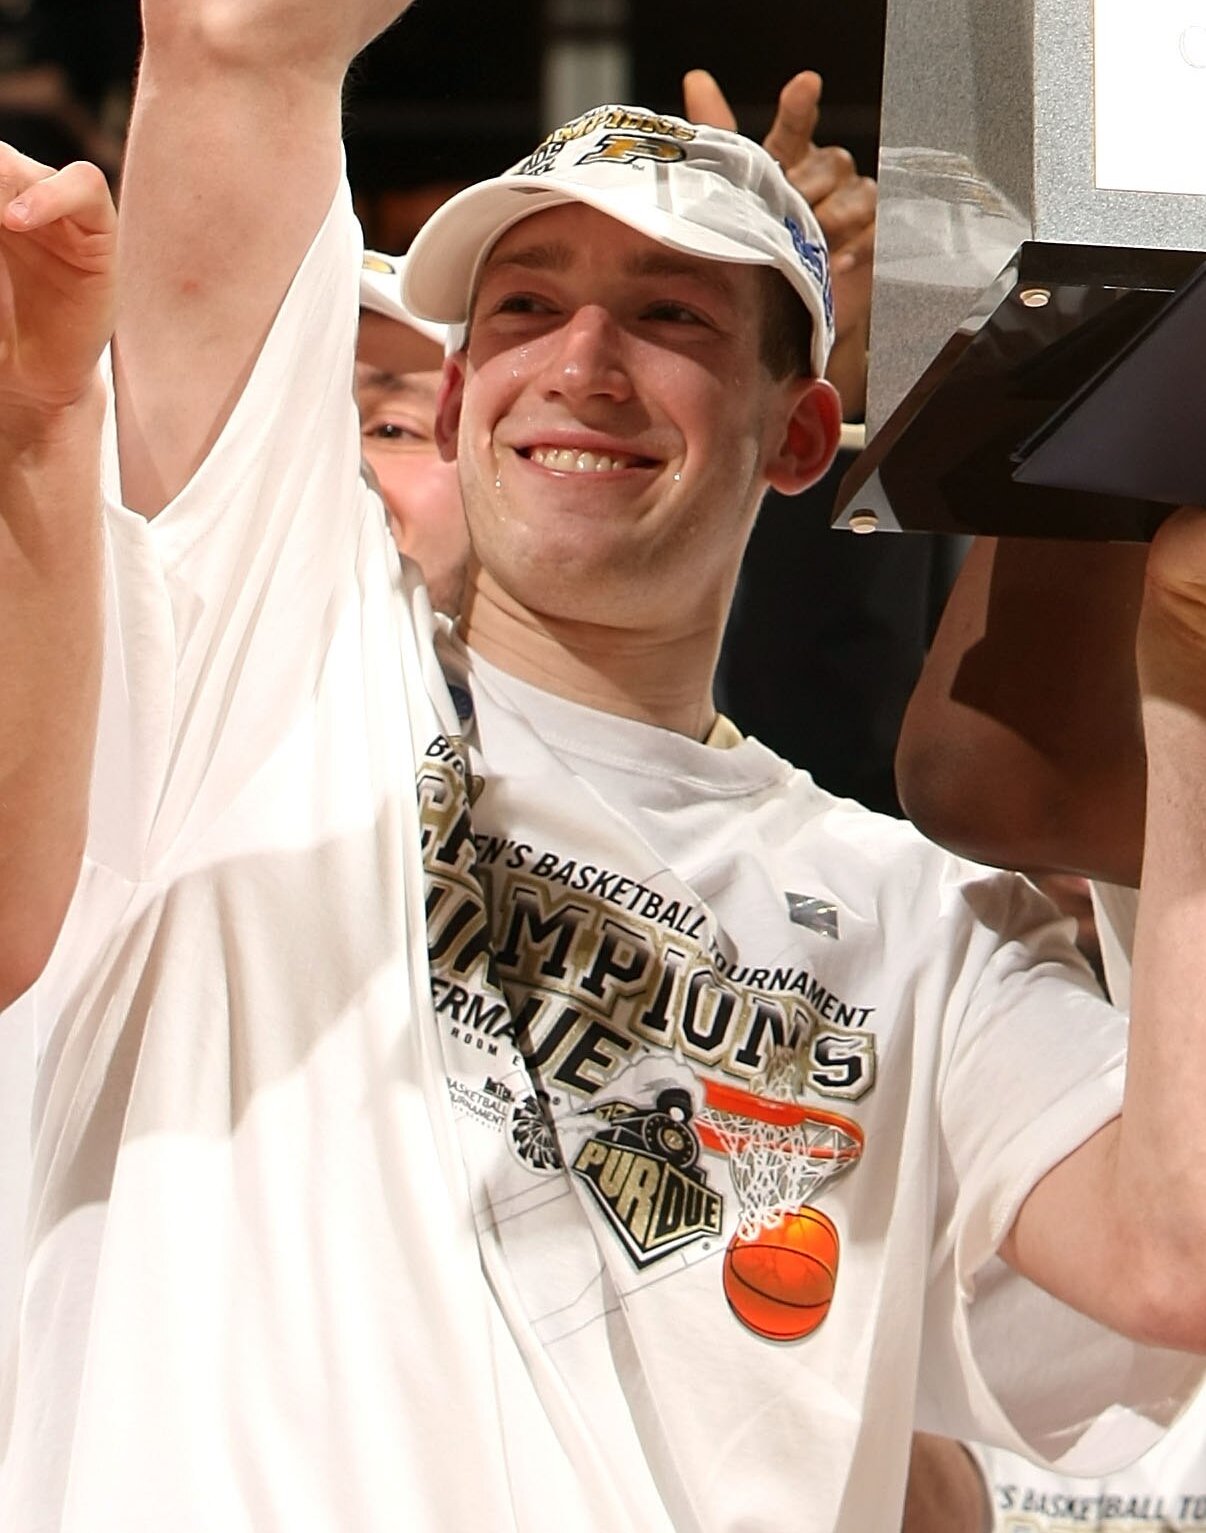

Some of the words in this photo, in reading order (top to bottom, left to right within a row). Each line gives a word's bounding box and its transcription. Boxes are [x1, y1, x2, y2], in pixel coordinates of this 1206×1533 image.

[530, 853, 707, 940] BASKETBALL
[707, 935, 876, 1029] TOURNAMENT
[574, 1140, 719, 1247] PURDUE
[1021, 1488, 1167, 1520] BASKETBALL
